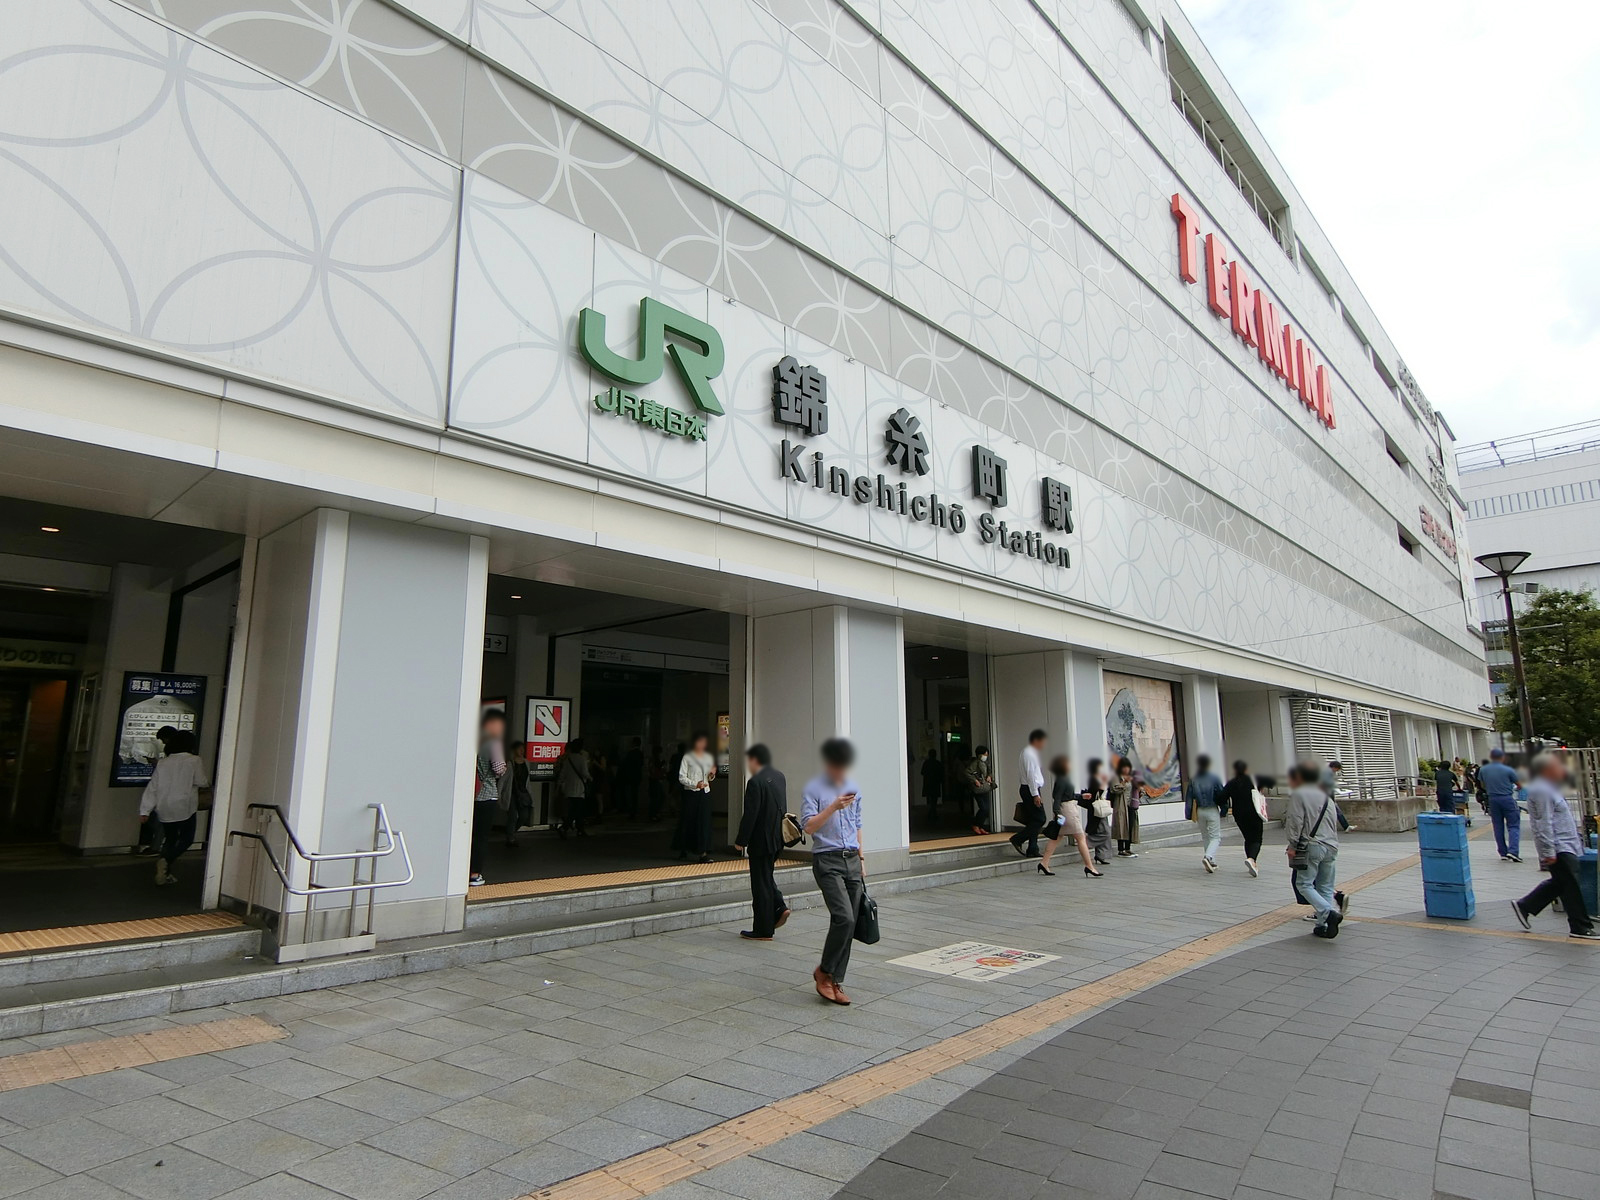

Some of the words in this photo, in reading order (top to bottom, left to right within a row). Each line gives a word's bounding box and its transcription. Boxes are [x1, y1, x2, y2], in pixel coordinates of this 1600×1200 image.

[1171, 192, 1336, 430] TERMINA
[579, 297, 725, 416] JR
[594, 387, 708, 442] JR東日本
[772, 355, 1074, 535] 錦糸町駅
[780, 439, 967, 534] Kinshichō
[979, 511, 1072, 569] Station
[0, 647, 76, 666] りの窓口
[131, 679, 152, 692] 募集
[532, 745, 561, 759] 日能研
